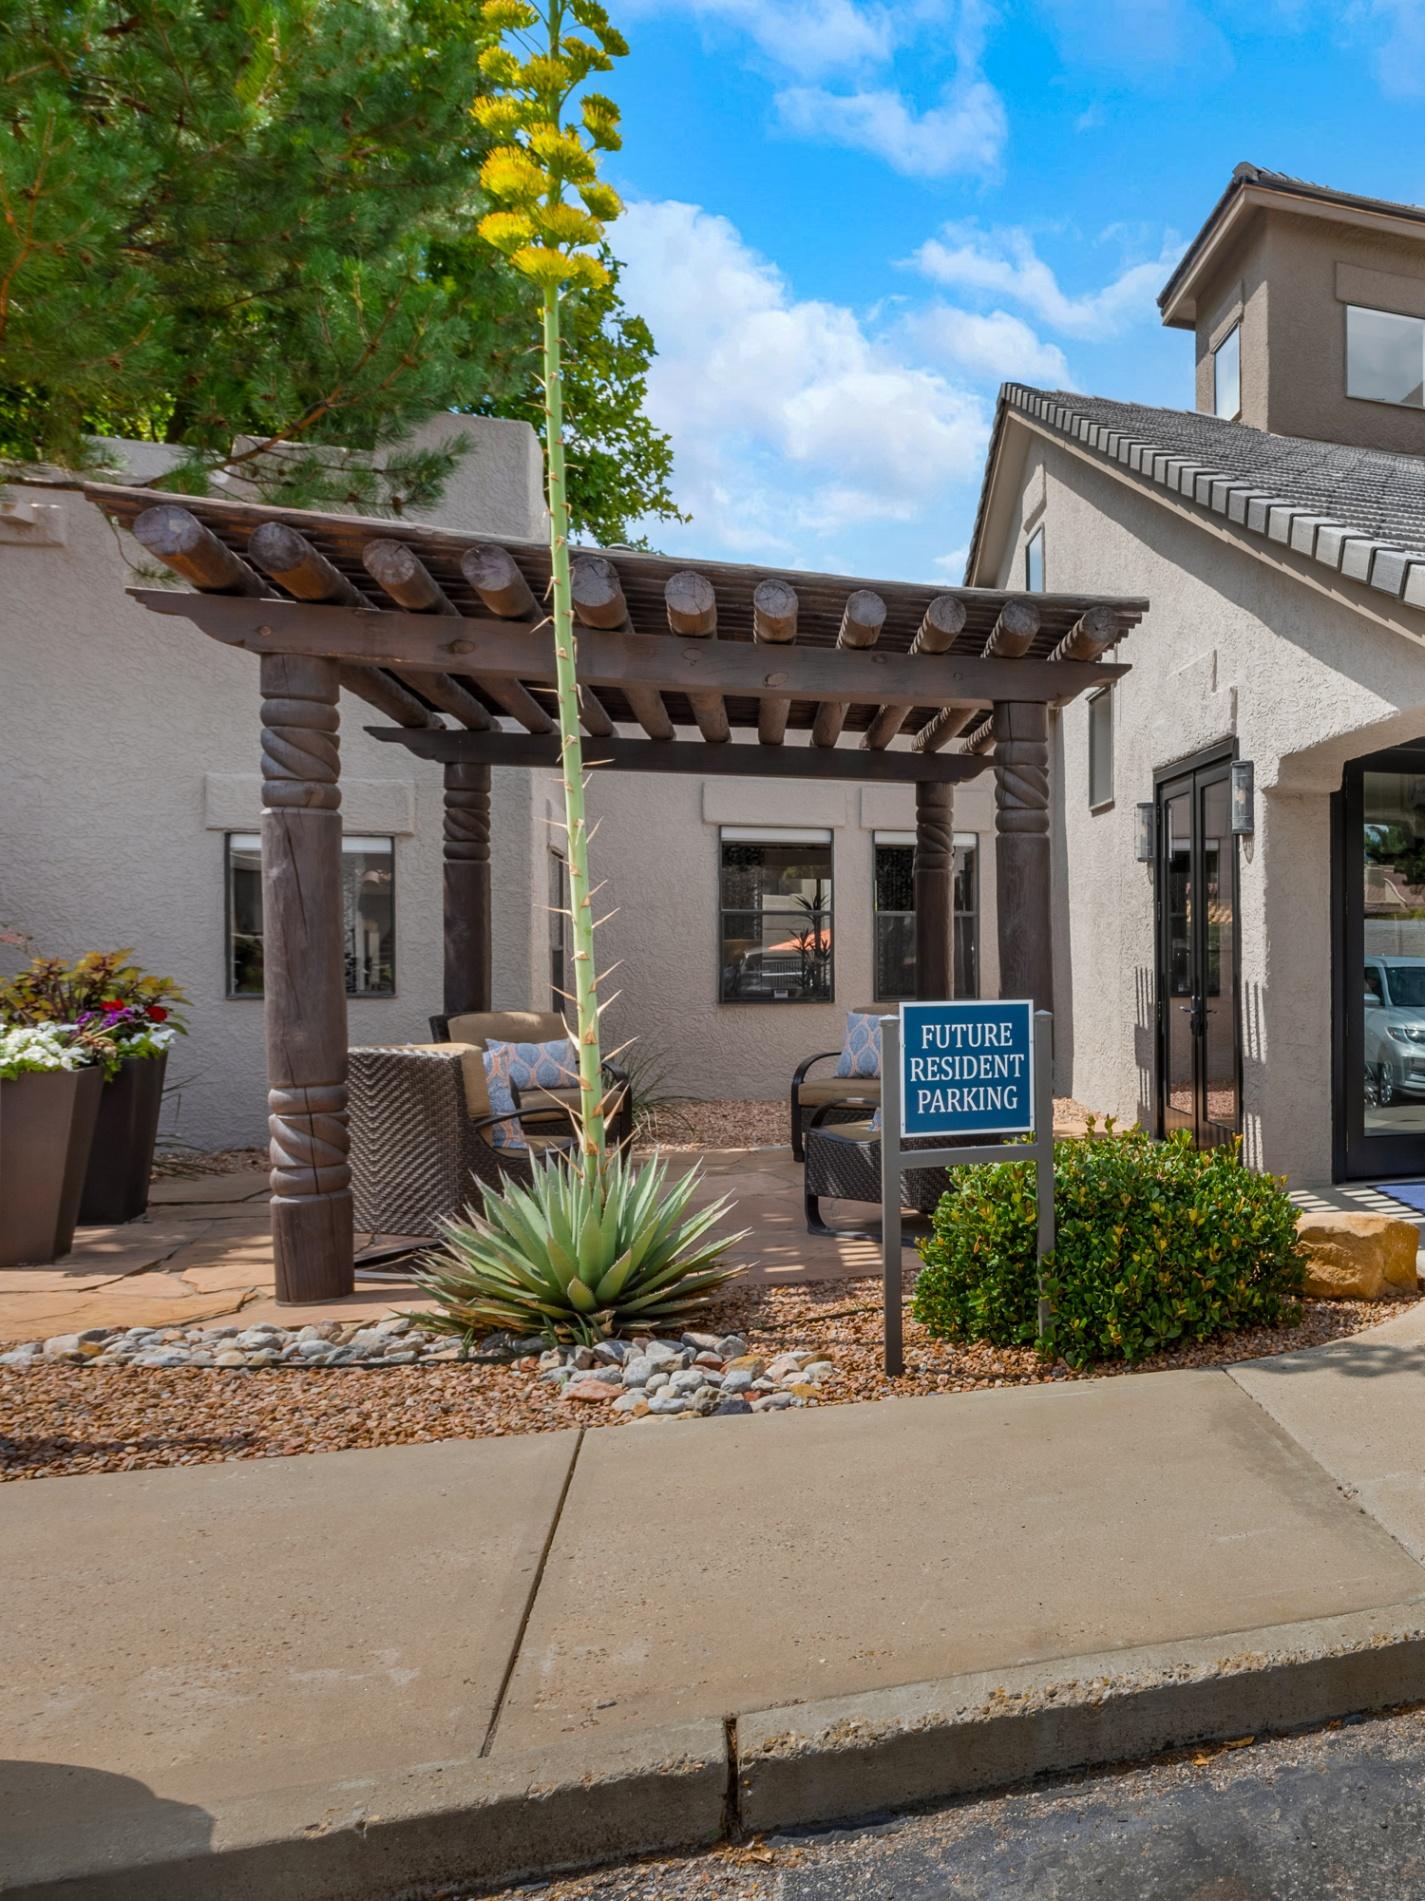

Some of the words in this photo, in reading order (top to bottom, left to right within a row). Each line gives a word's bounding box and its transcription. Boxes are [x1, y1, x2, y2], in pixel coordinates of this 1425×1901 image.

[921, 1022, 1013, 1049] FUTURE
[910, 1053, 1025, 1082] RESIDENT
[917, 1085, 1018, 1114] PARKING
